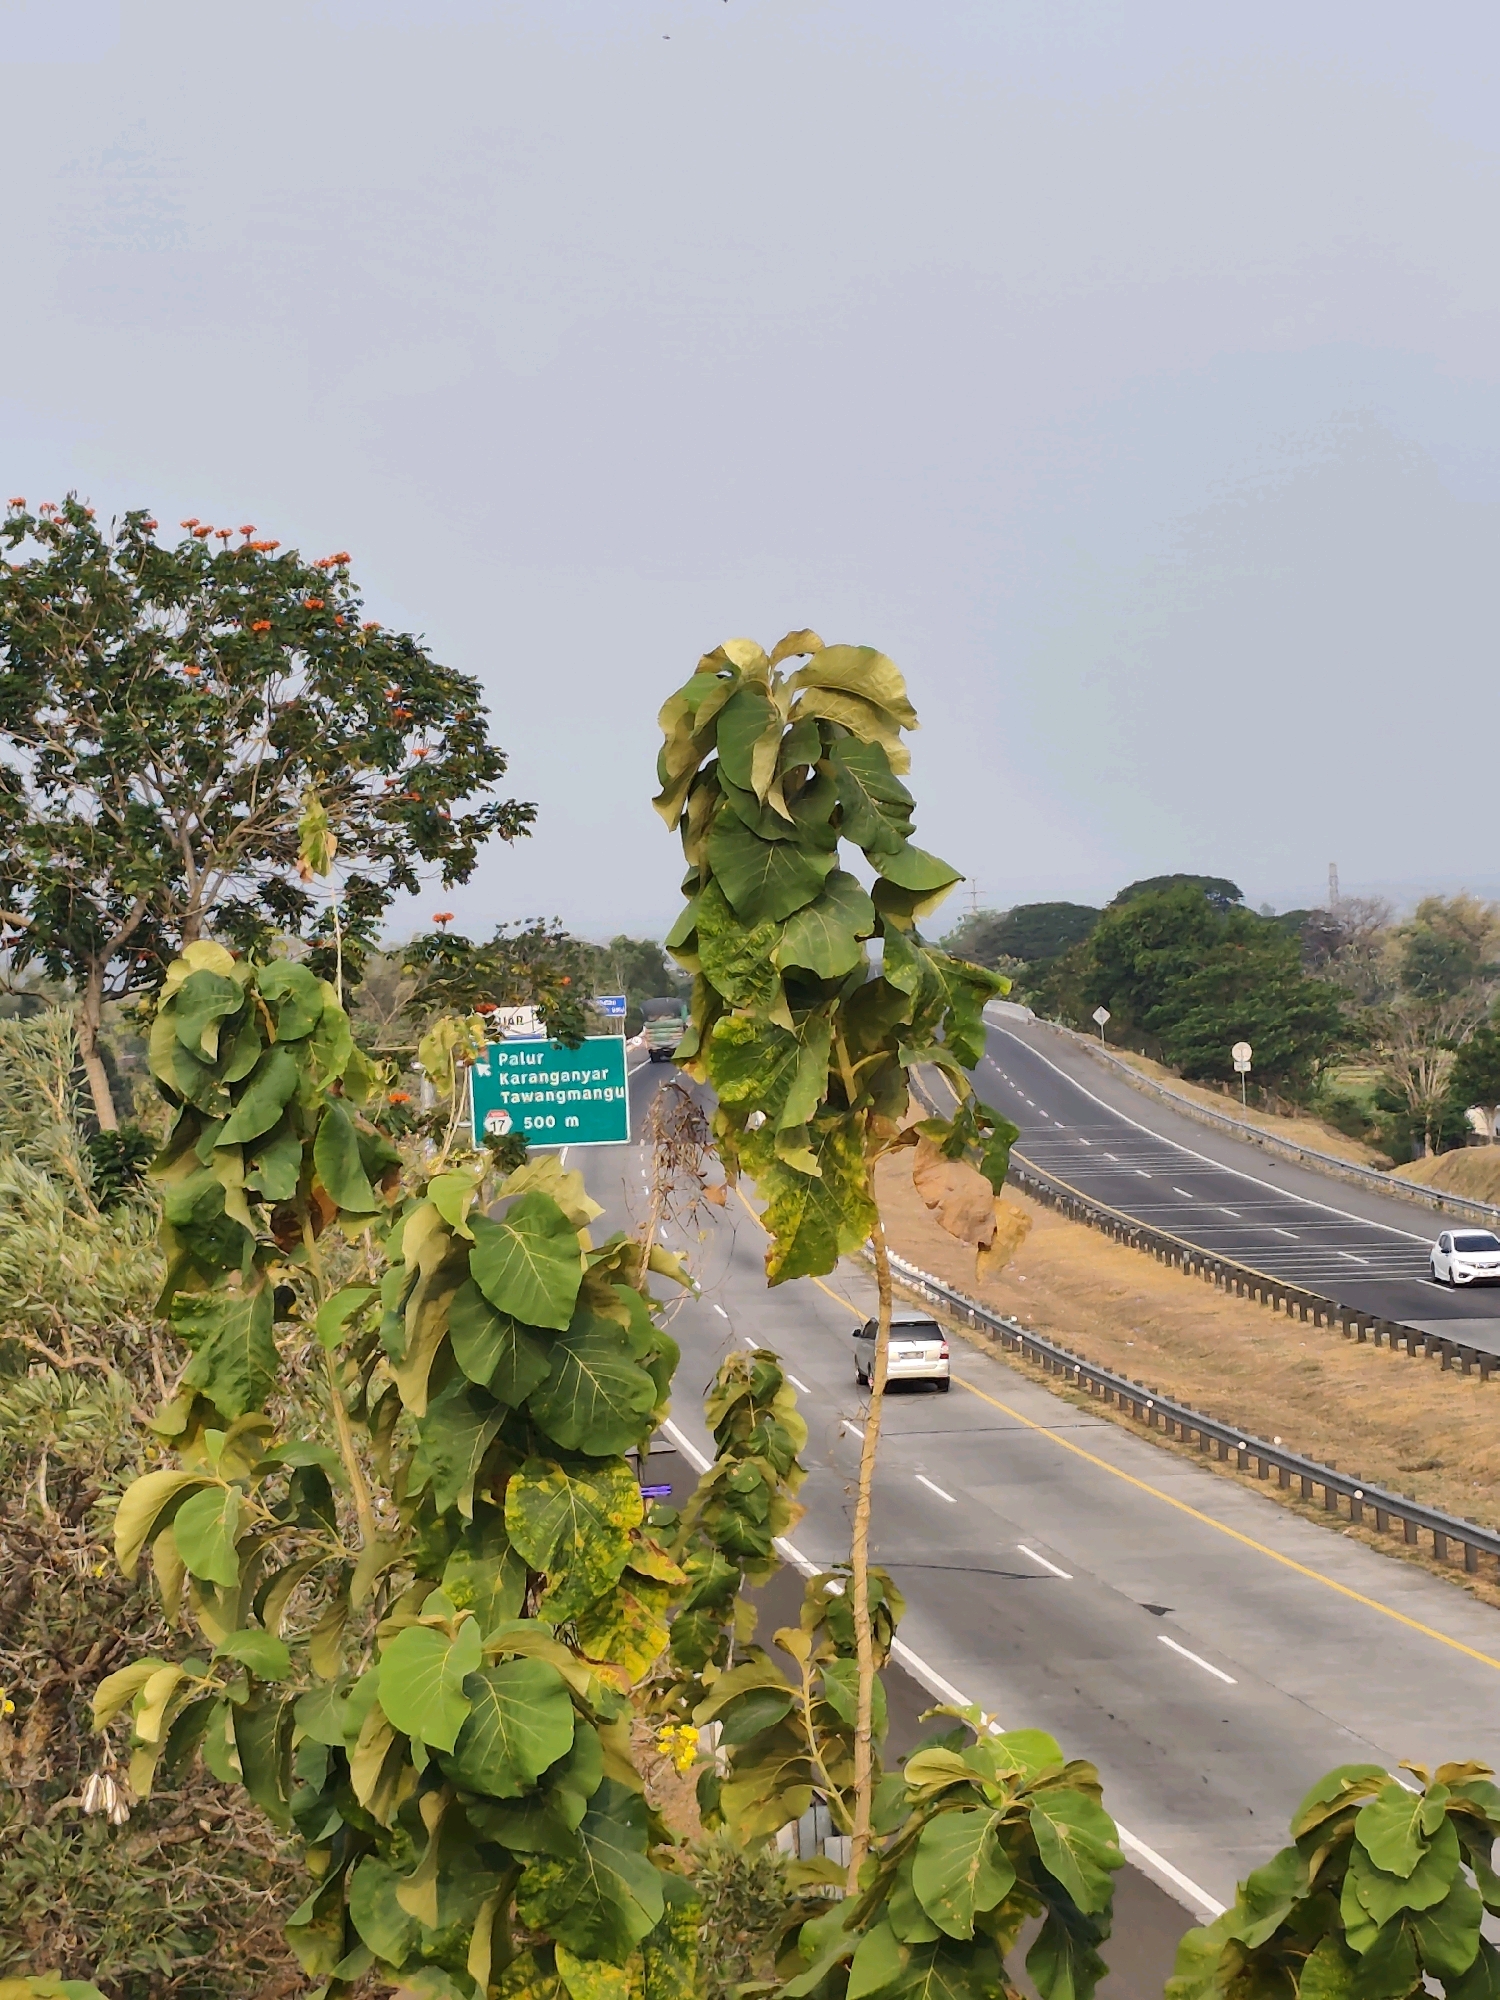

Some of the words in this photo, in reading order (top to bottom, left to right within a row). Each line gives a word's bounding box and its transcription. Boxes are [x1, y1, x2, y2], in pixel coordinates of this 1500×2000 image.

[498, 1051, 545, 1067] Palur
[499, 1067, 609, 1086] Karanganyar
[501, 1085, 625, 1104] Tawangmangu
[490, 1119, 506, 1132] 17
[523, 1115, 556, 1130] 500
[565, 1115, 580, 1128] m
